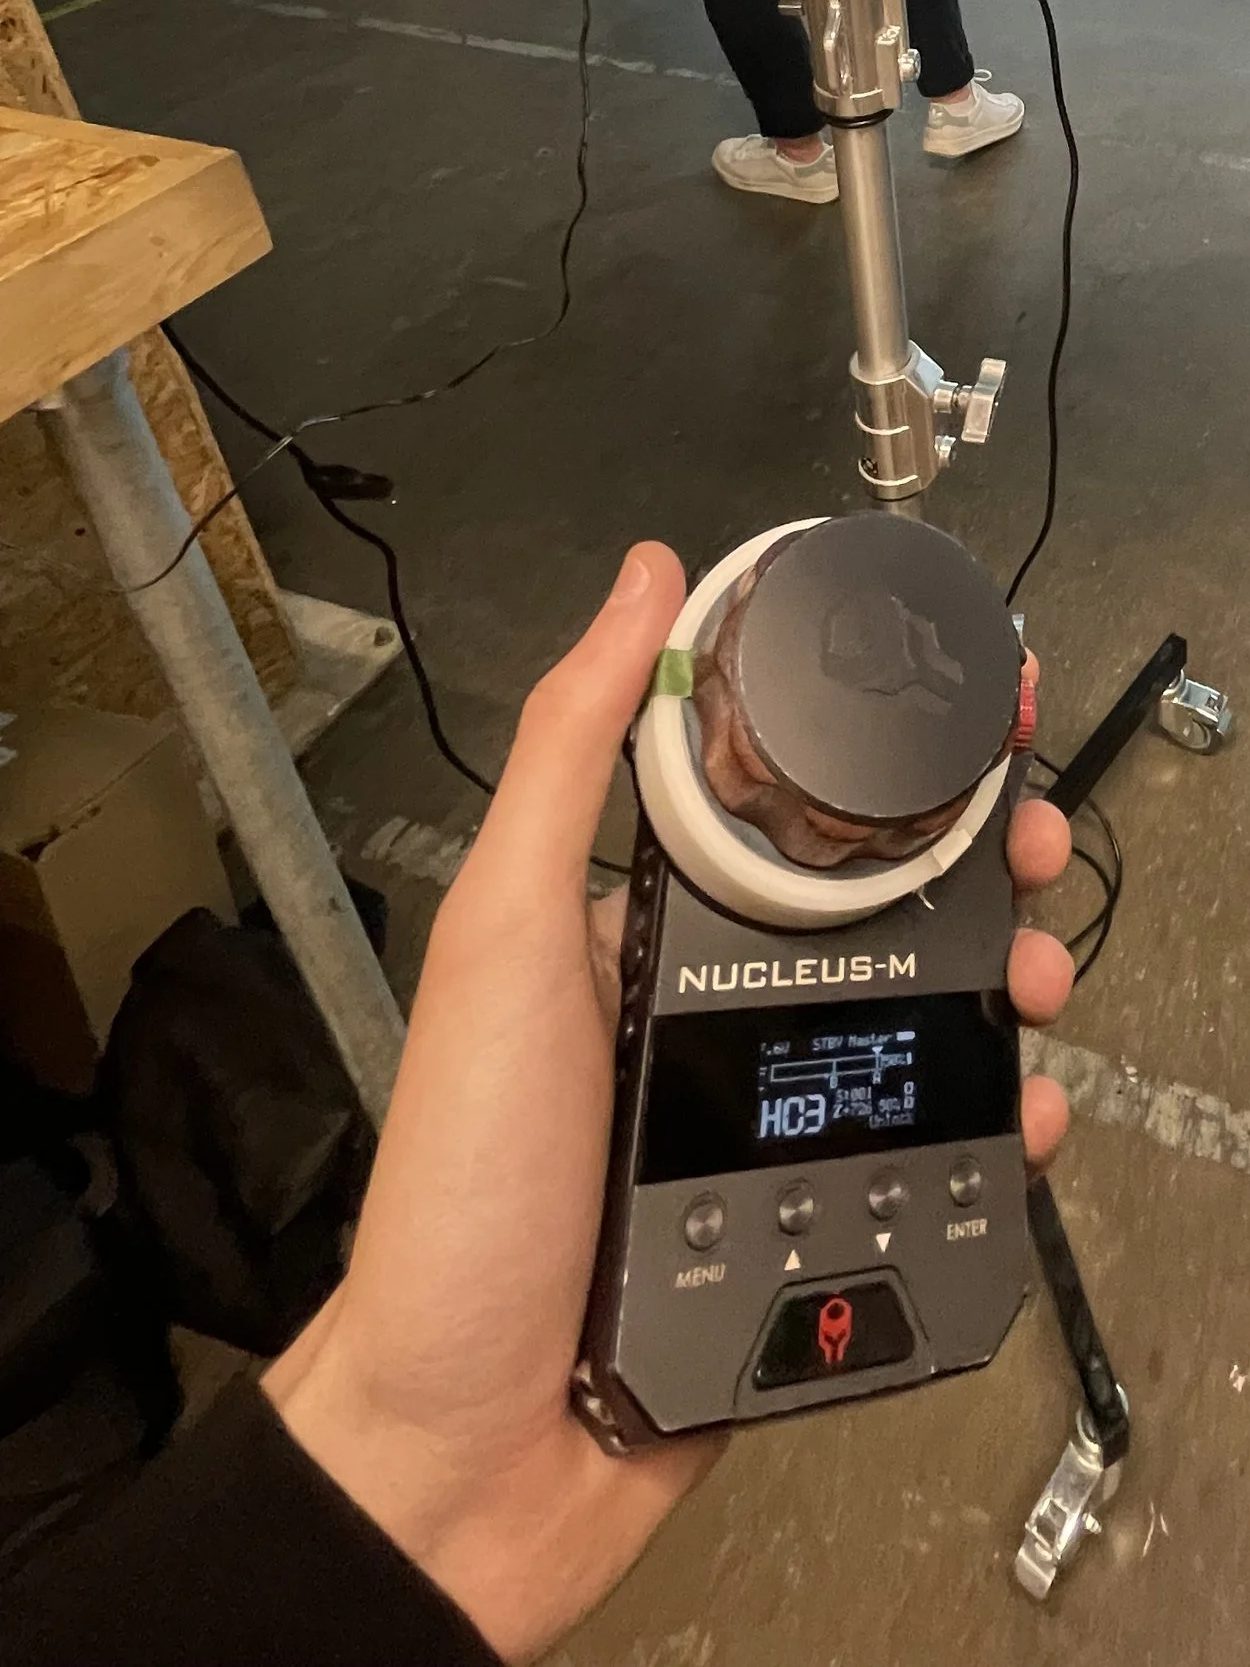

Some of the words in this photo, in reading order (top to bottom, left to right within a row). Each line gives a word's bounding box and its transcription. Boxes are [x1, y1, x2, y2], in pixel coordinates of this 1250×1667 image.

[677, 952, 917, 994] NUCLEUS-M
[946, 1218, 988, 1241] ENTER
[675, 1263, 727, 1288] MENU
